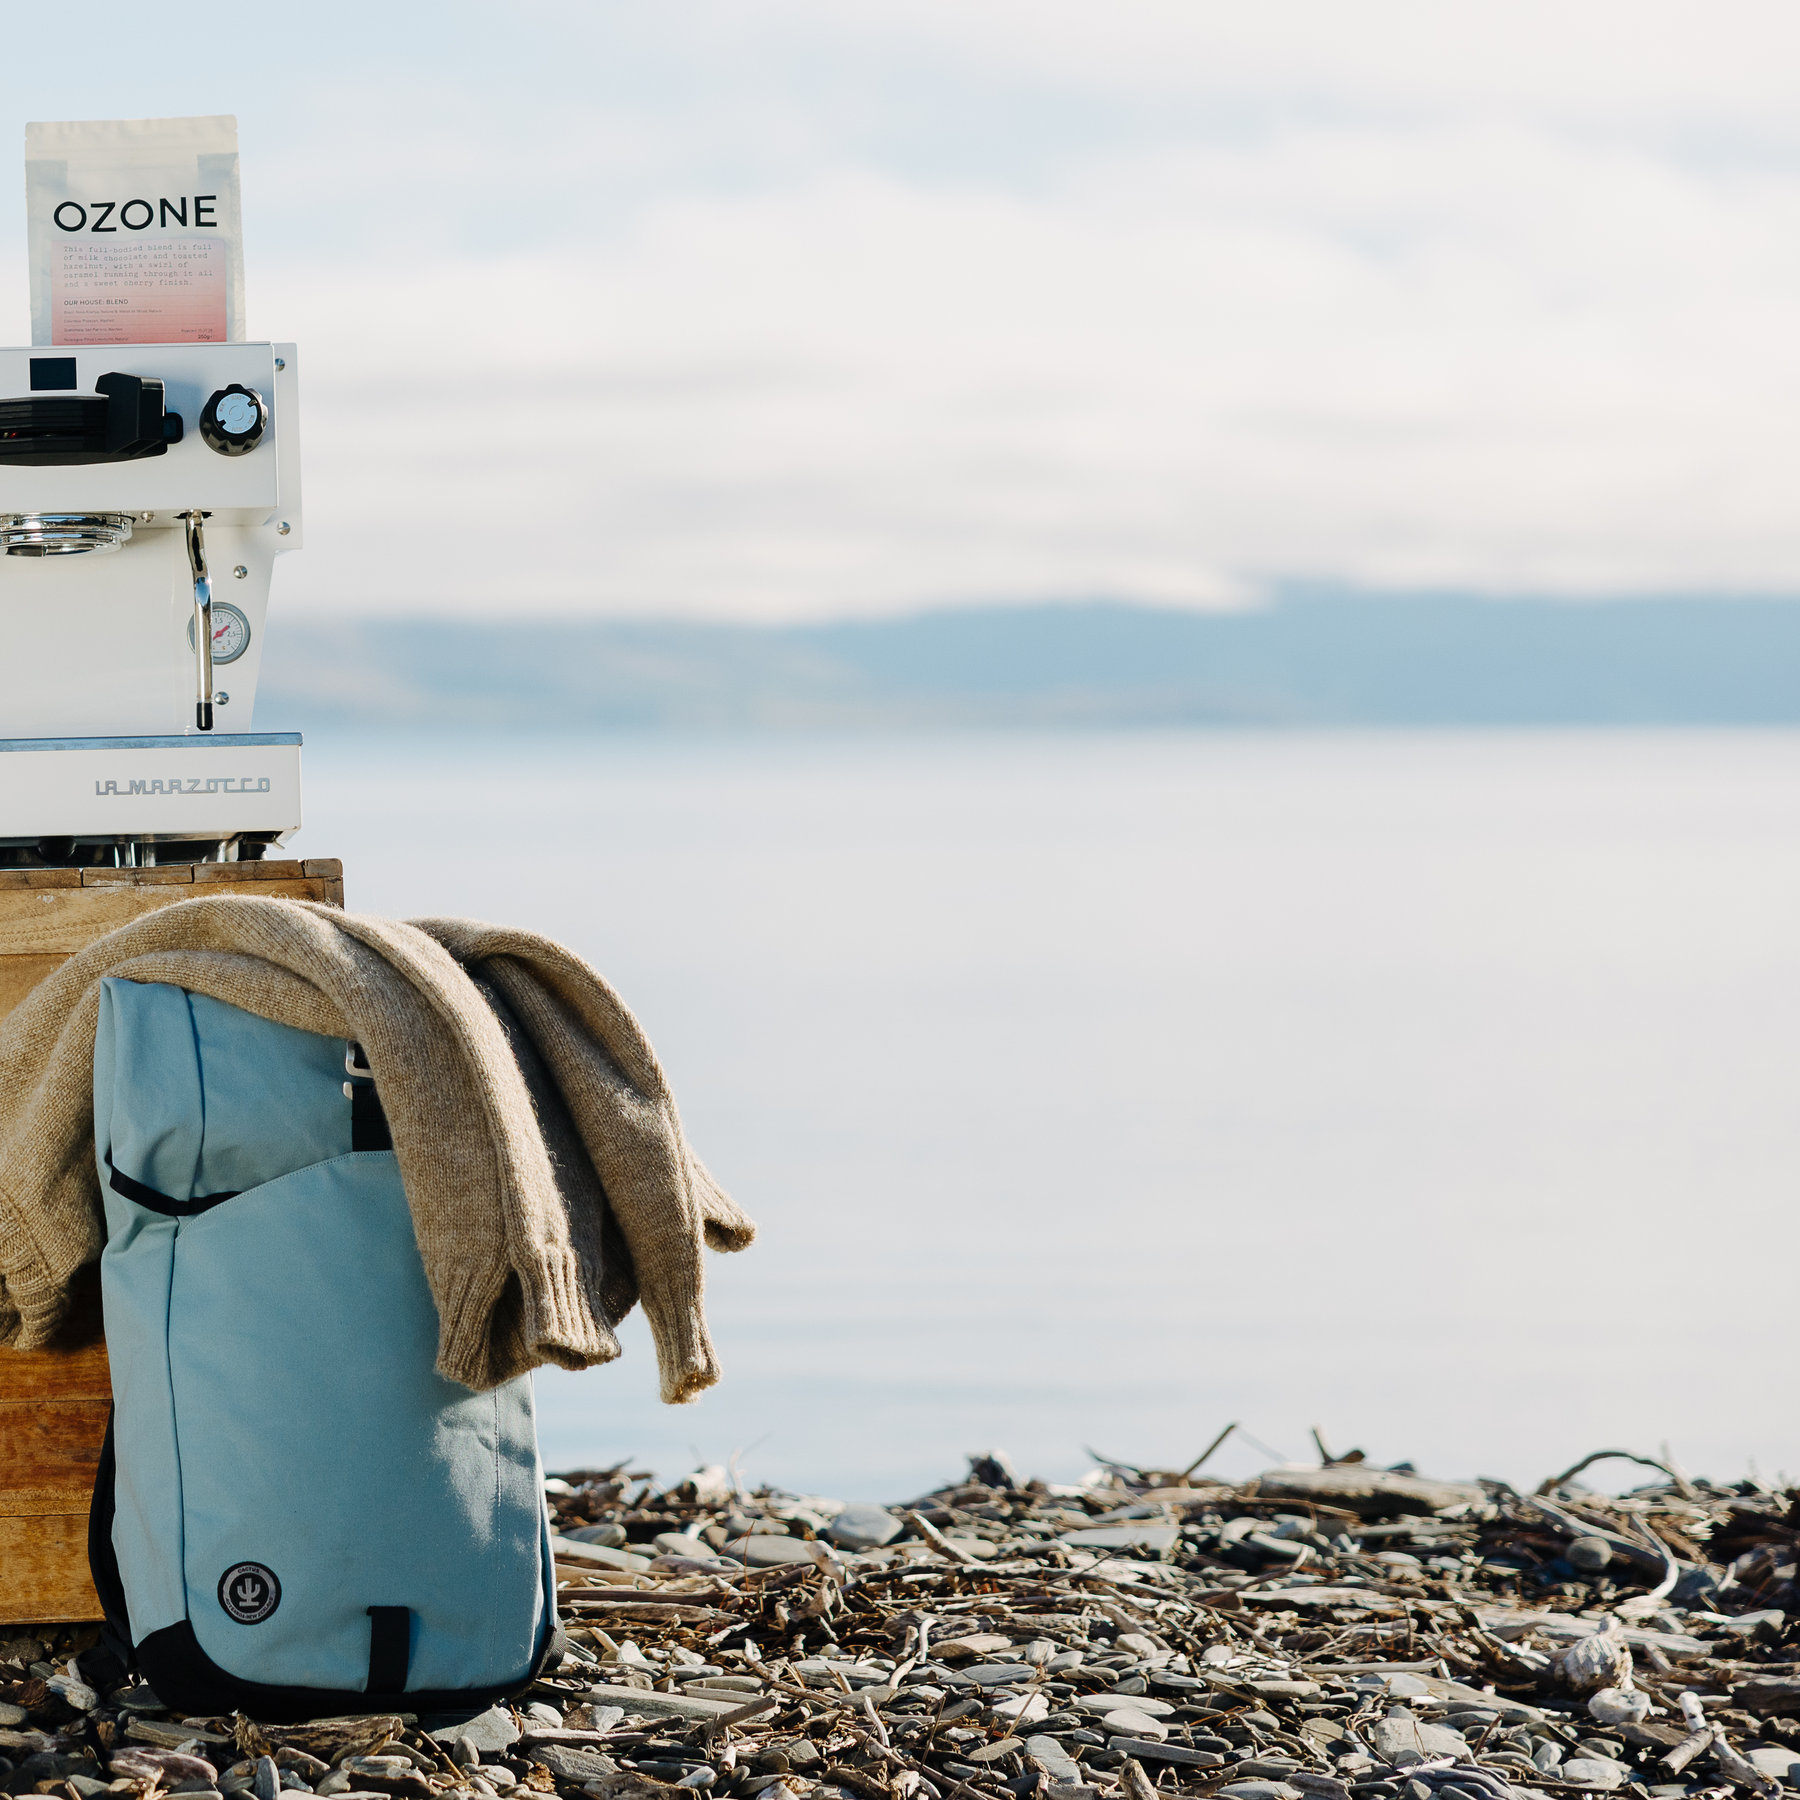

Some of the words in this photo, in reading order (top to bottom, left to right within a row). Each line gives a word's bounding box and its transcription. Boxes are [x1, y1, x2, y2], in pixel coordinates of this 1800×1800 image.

[53, 195, 218, 232] OZONE
[89, 245, 143, 253] full-bodied
[144, 270, 178, 278] through
[123, 279, 154, 287] cherry
[95, 780, 117, 796] LA
[129, 778, 270, 795] MARZOCCO
